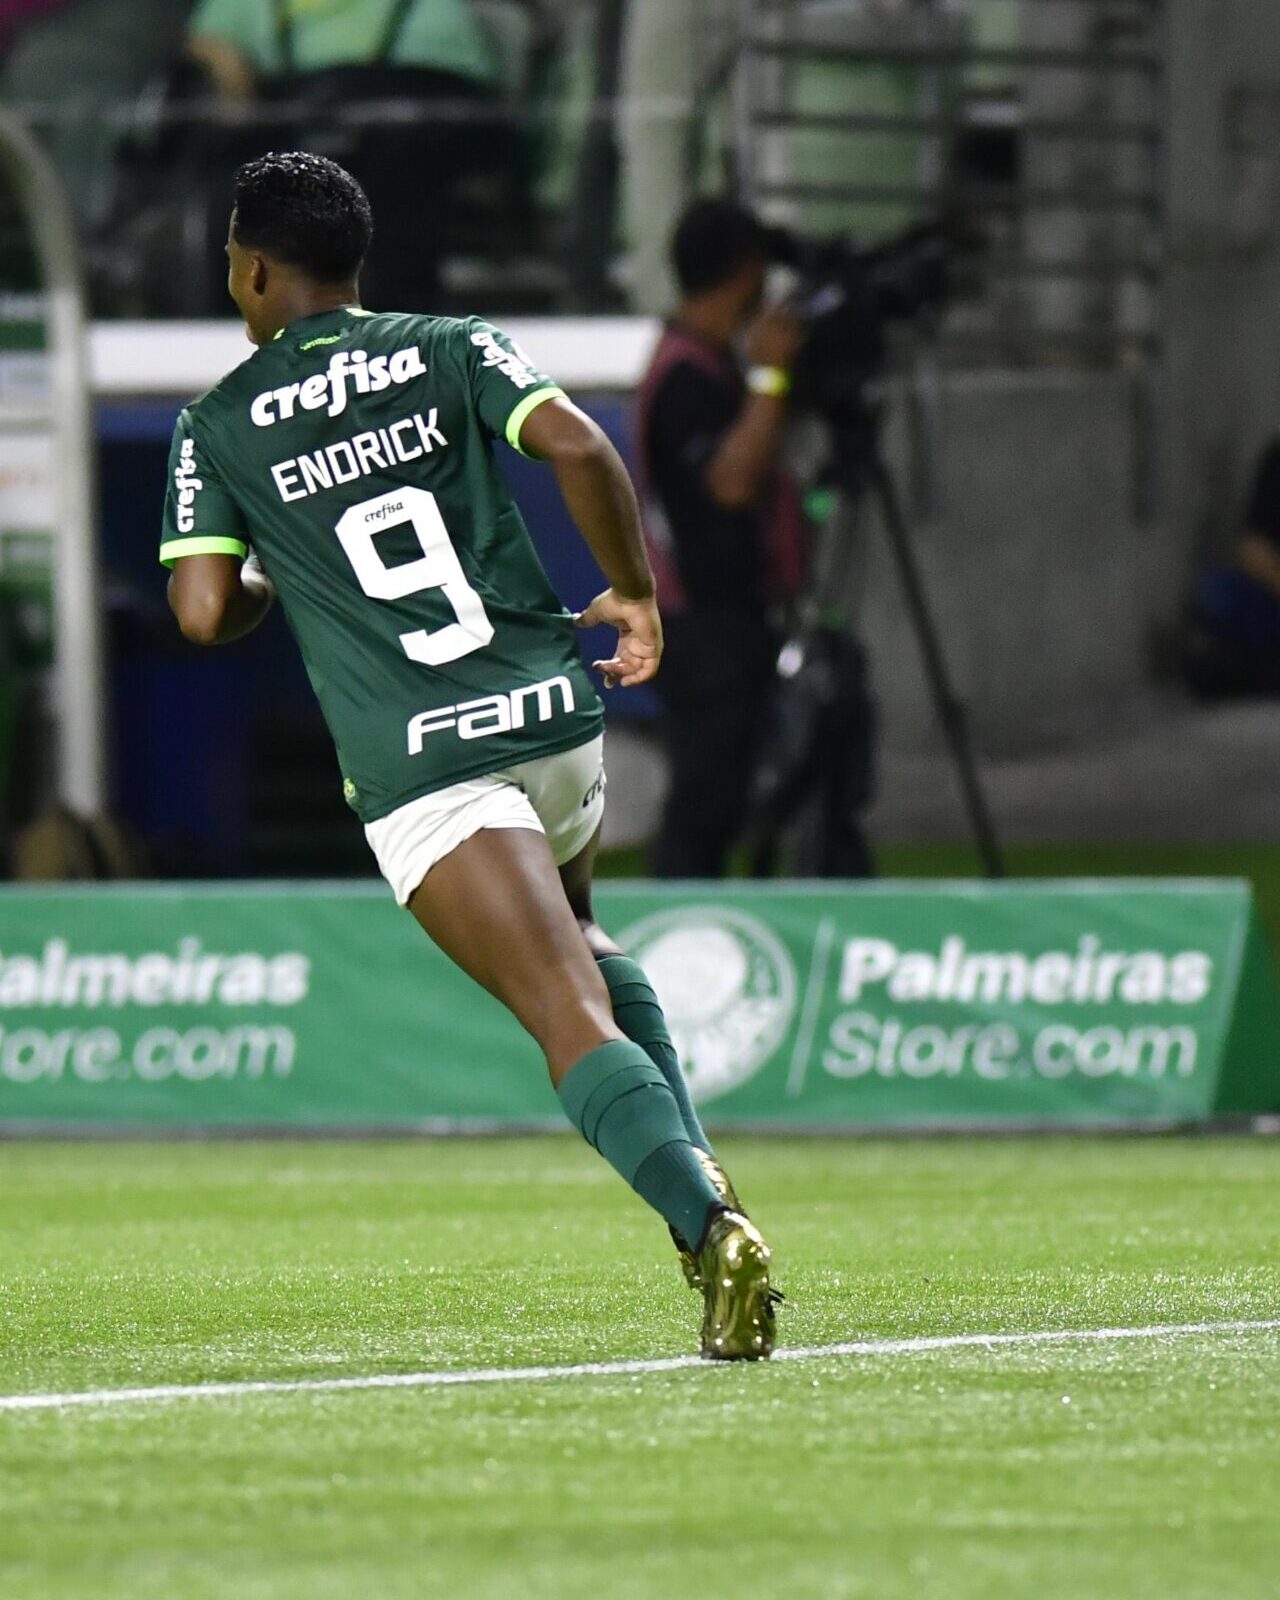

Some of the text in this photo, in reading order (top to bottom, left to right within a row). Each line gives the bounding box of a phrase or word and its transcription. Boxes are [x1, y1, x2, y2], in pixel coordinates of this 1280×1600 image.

[251, 346, 427, 427] crefisa
[174, 438, 203, 533] crefisa
[270, 407, 448, 503] ENDRICK
[364, 501, 404, 523] crefisa
[334, 485, 495, 666] 9
[838, 933, 1214, 1005] Palmeiras
[822, 1011, 1199, 1080] Store.com
